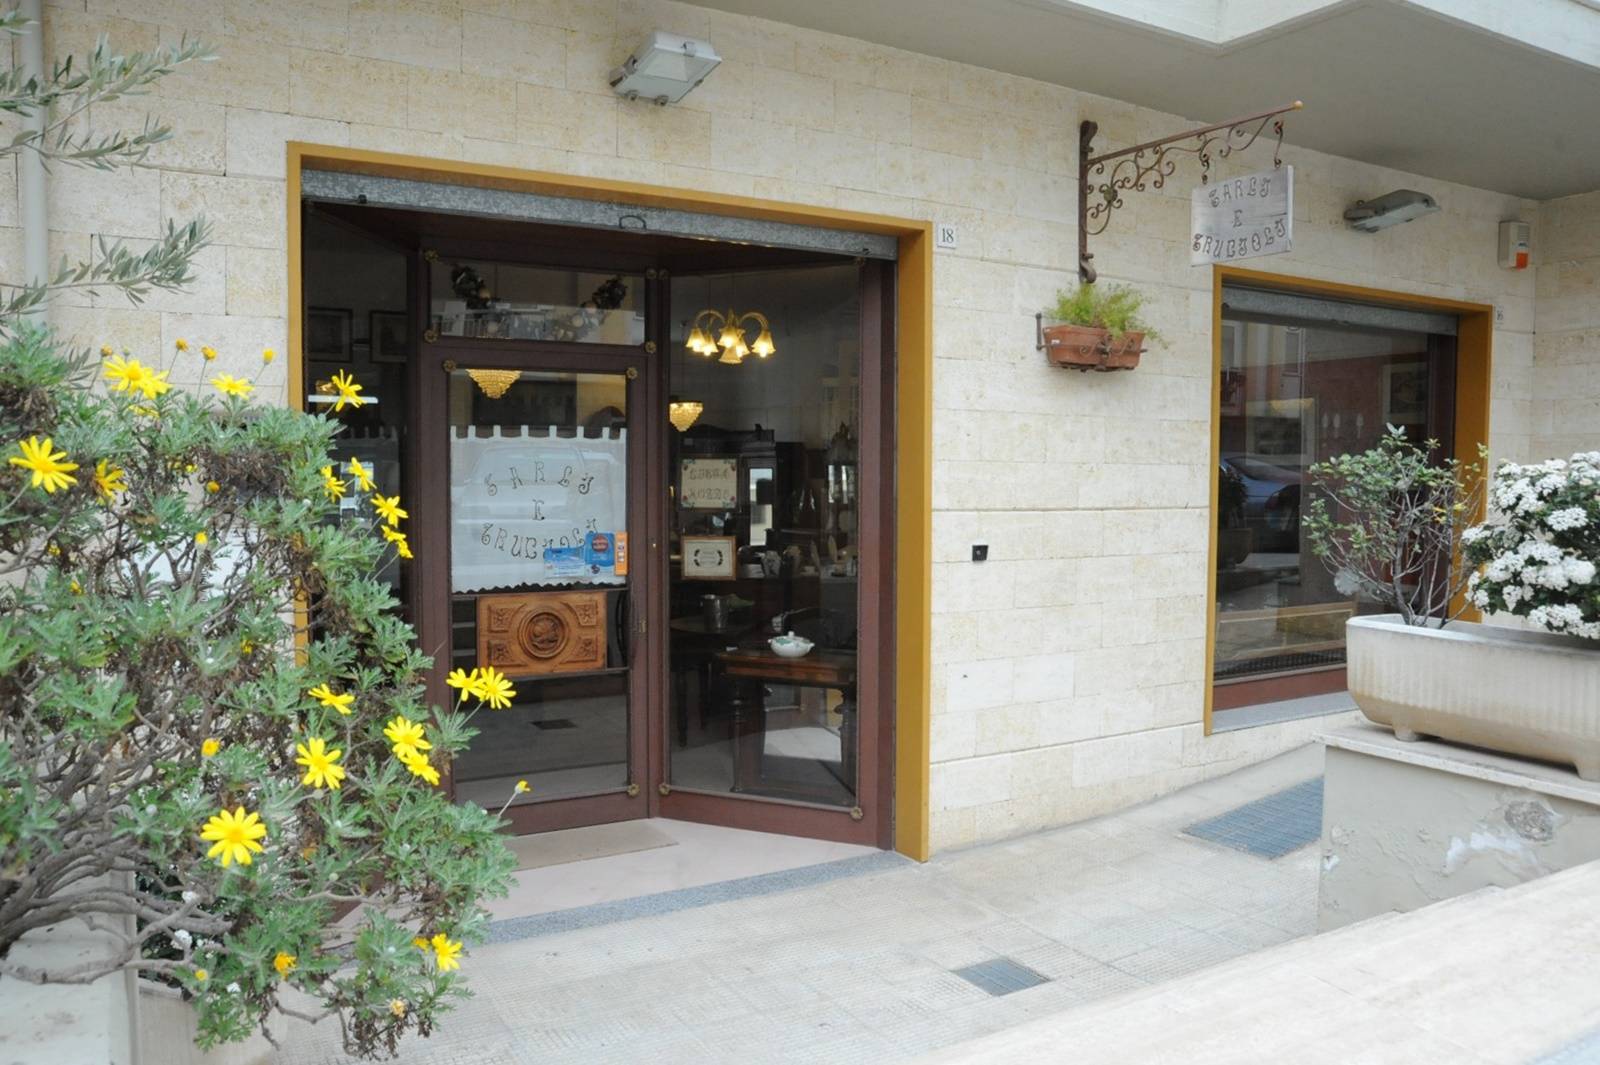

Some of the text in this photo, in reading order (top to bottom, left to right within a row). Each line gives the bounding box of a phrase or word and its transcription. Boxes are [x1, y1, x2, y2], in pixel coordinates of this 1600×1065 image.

[1208, 176, 1271, 208] TARLI
[1232, 209, 1243, 228] E
[942, 228, 954, 244] 18
[1193, 217, 1286, 258] TRUCIOLI
[484, 461, 595, 497] TARLI
[532, 499, 545, 521] E
